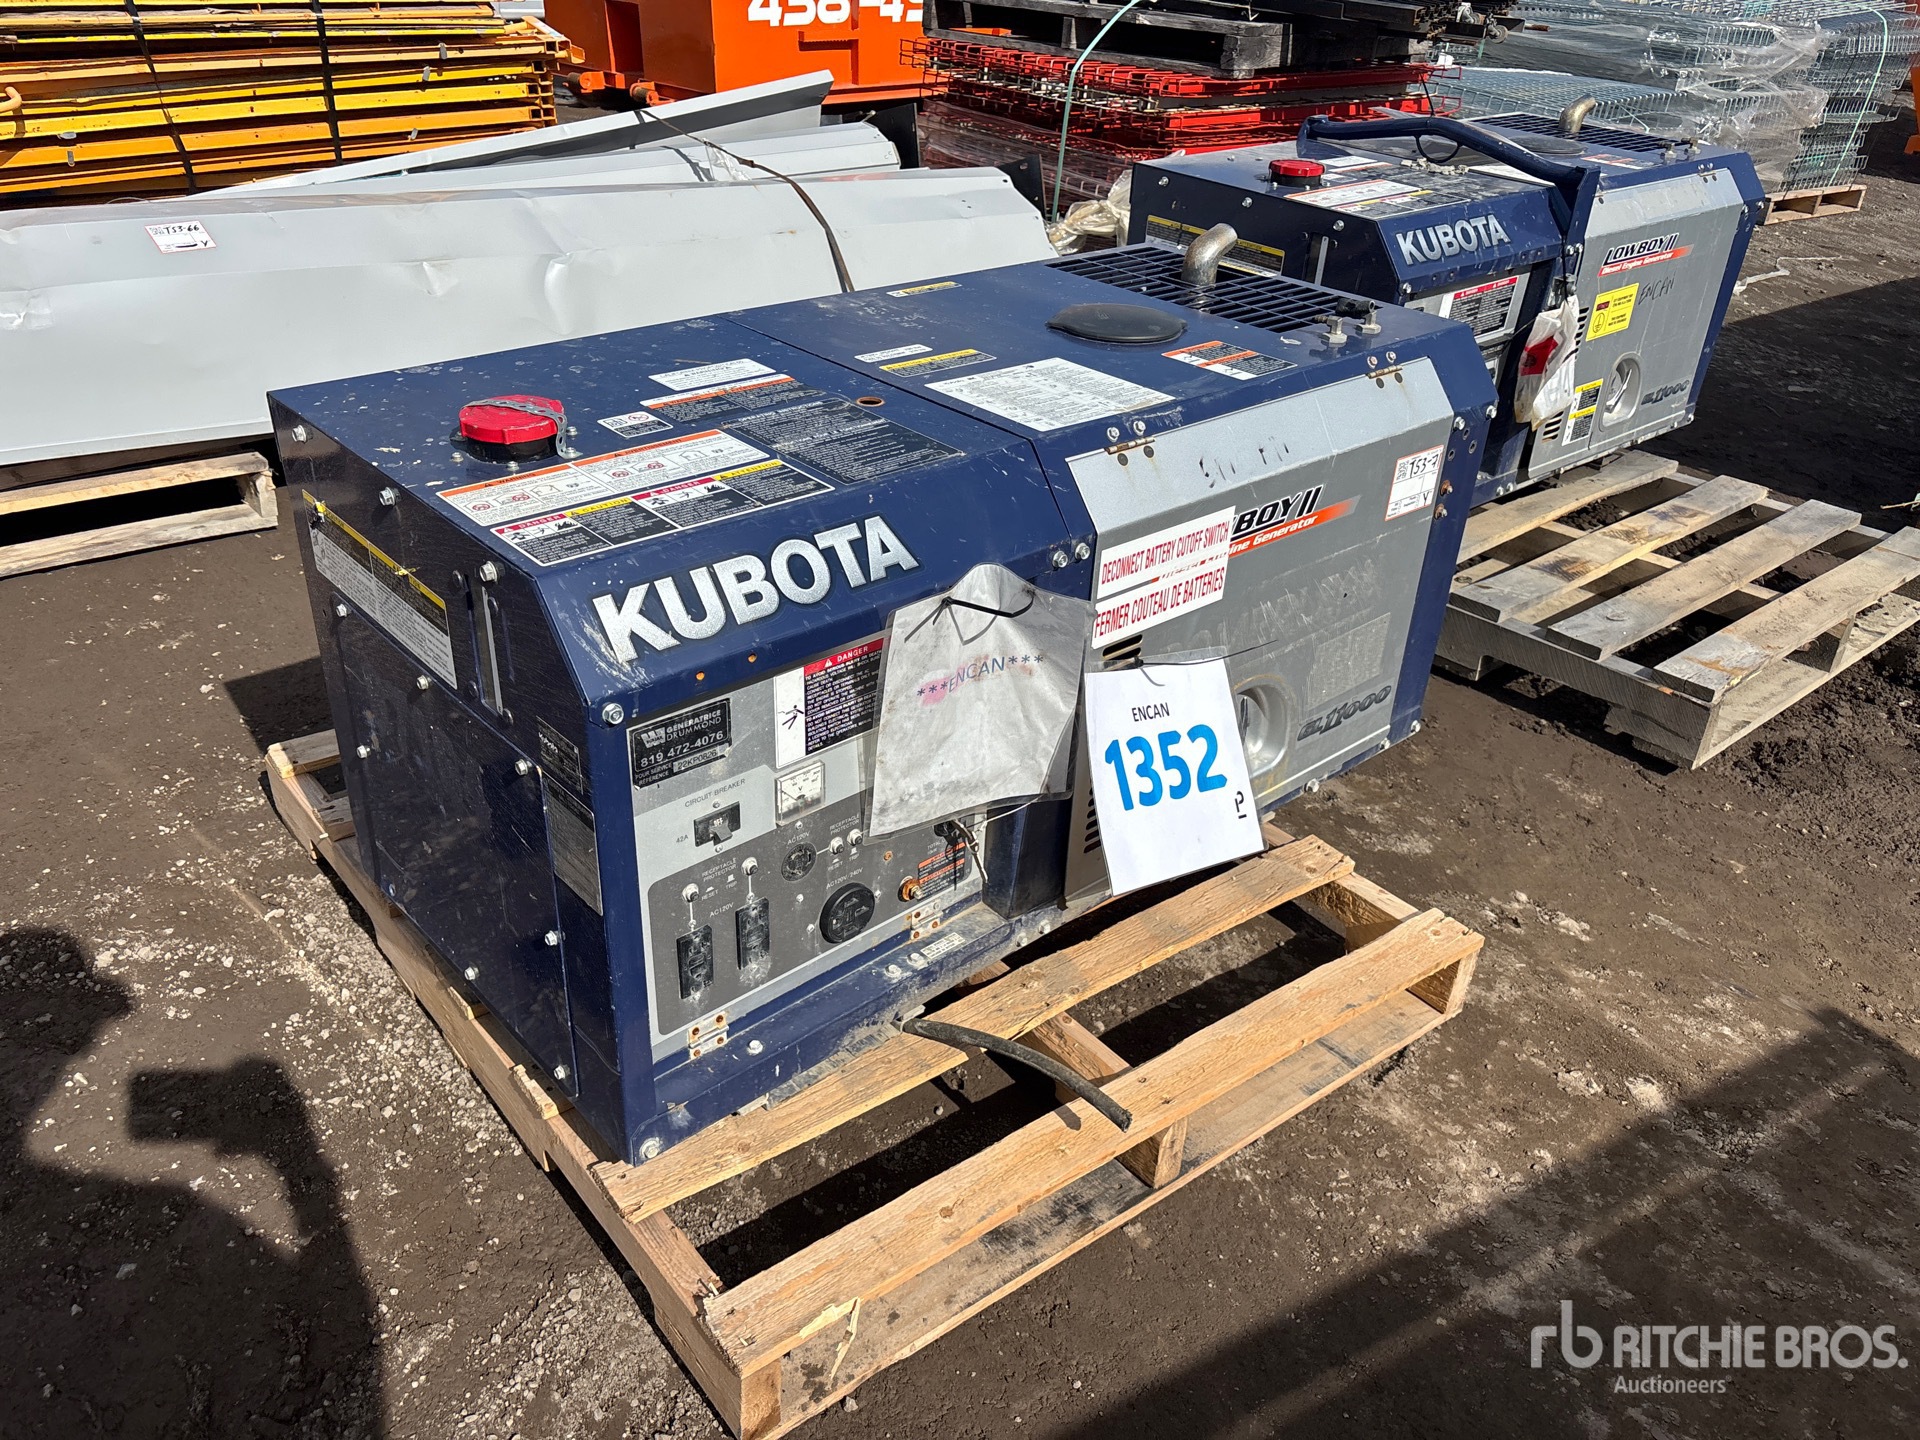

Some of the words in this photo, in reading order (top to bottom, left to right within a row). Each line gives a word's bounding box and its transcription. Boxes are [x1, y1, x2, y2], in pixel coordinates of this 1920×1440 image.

[1396, 214, 1511, 265] KUBOTA
[518, 514, 561, 530] DANGER
[581, 497, 630, 514] CAUTION
[1231, 491, 1302, 536] BOY
[1229, 540, 1251, 555] ine
[1253, 515, 1318, 546] Generator
[1101, 549, 1146, 585] DECONNECT
[1145, 539, 1177, 569] BATTERY
[1176, 529, 1204, 559] CUTOFF
[1203, 520, 1230, 549] SWITCH
[592, 515, 920, 664] KUBOTA
[1094, 602, 1131, 638] FERMER
[1131, 587, 1171, 624] COUTEAU
[1170, 582, 1183, 609] DE
[1183, 566, 1225, 604] BATTERIES
[837, 646, 869, 663] DANGER
[1131, 702, 1170, 722] ENCAN
[666, 717, 722, 741] DRUMMOND
[640, 752, 664, 768] 819
[667, 730, 724, 758] 472-4076
[1105, 724, 1228, 812] 1352
[684, 791, 713, 808] CIRCUIT
[714, 778, 746, 797] BREAKER
[829, 813, 861, 831] RECEPTACLE
[830, 819, 860, 836] PROTECTOR
[787, 831, 811, 846] AC120V
[701, 857, 737, 878] RECEPTACLE
[703, 864, 737, 883] PROTECTOR
[701, 889, 719, 901] RESET
[709, 902, 735, 918] AC120V
